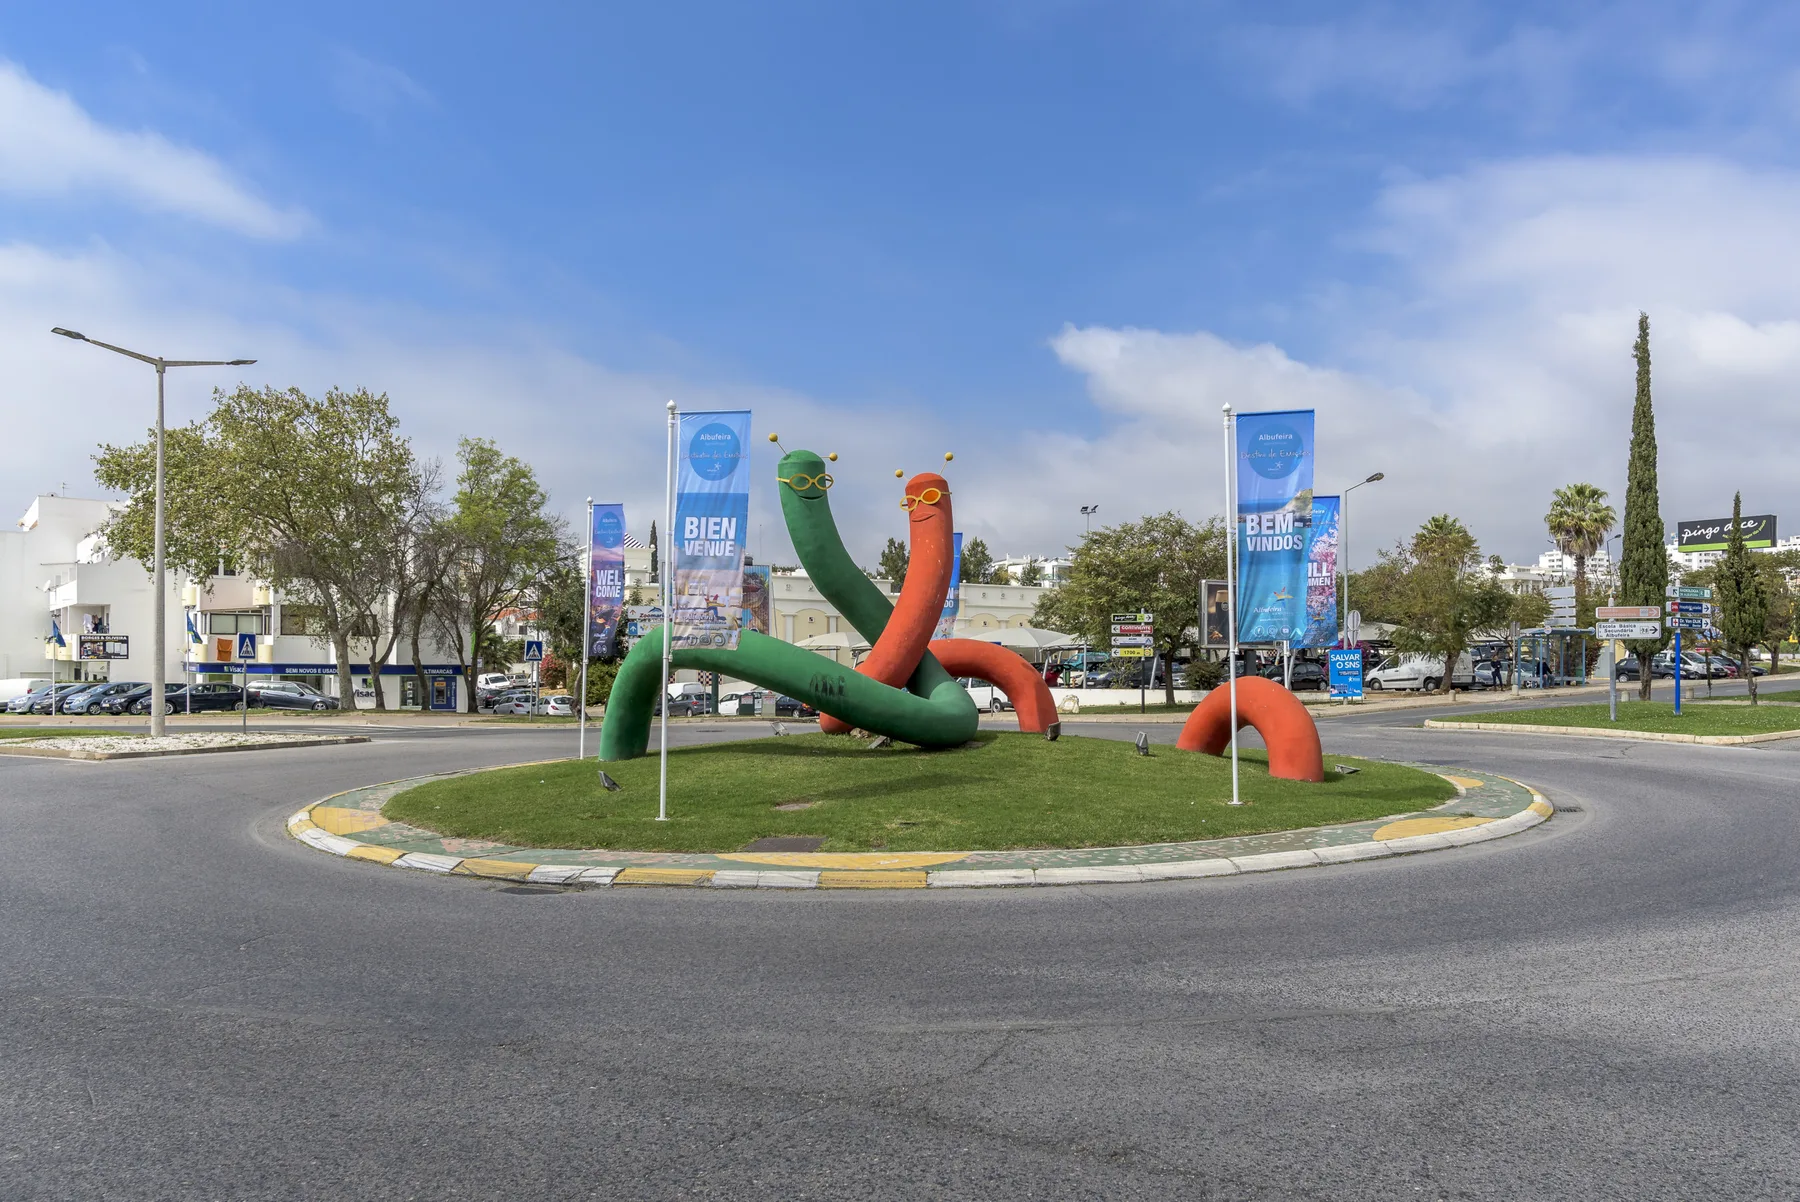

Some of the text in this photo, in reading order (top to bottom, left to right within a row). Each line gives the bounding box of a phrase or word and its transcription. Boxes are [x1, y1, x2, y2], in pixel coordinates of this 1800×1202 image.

[1258, 433, 1293, 441] Albufeira
[685, 517, 736, 540] BIEN
[1246, 513, 1304, 535] BEM-
[1681, 520, 1758, 544] pingo dce
[684, 540, 735, 557] VENUE
[1246, 534, 1303, 552] VINDOS
[1307, 561, 1331, 577] ILL
[596, 569, 622, 586] WEL
[1307, 577, 1331, 587] MEN
[595, 585, 622, 598] COME
[1330, 653, 1360, 661] SALVAR
[1344, 661, 1360, 669] SNS
